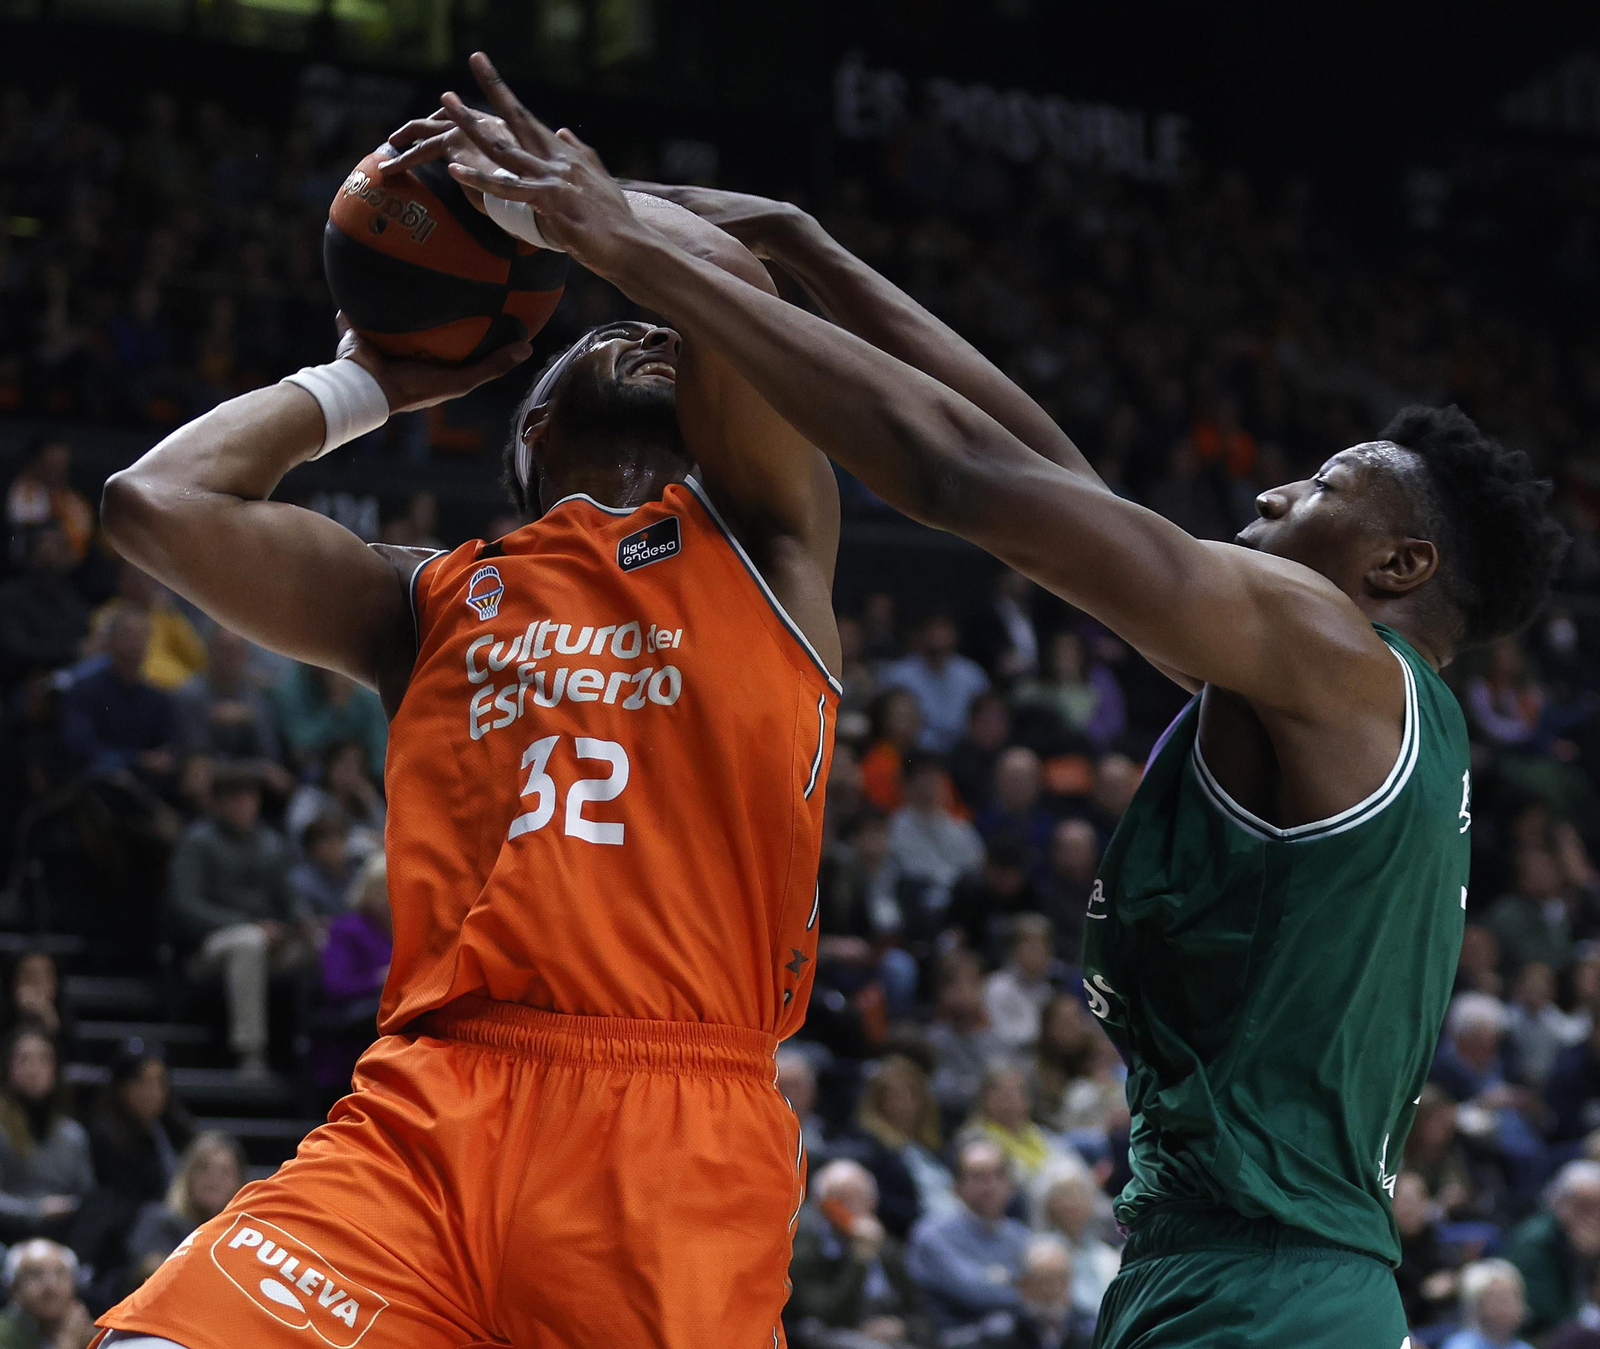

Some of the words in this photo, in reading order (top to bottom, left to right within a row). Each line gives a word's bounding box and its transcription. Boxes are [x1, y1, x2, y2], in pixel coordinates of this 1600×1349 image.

[623, 540, 647, 555] liga
[623, 540, 676, 565] endesa
[465, 618, 642, 684] Cultura
[646, 624, 683, 654] del
[469, 661, 682, 741] Esfuerzo
[507, 735, 630, 846] 32
[227, 1226, 360, 1329] PULEVA
